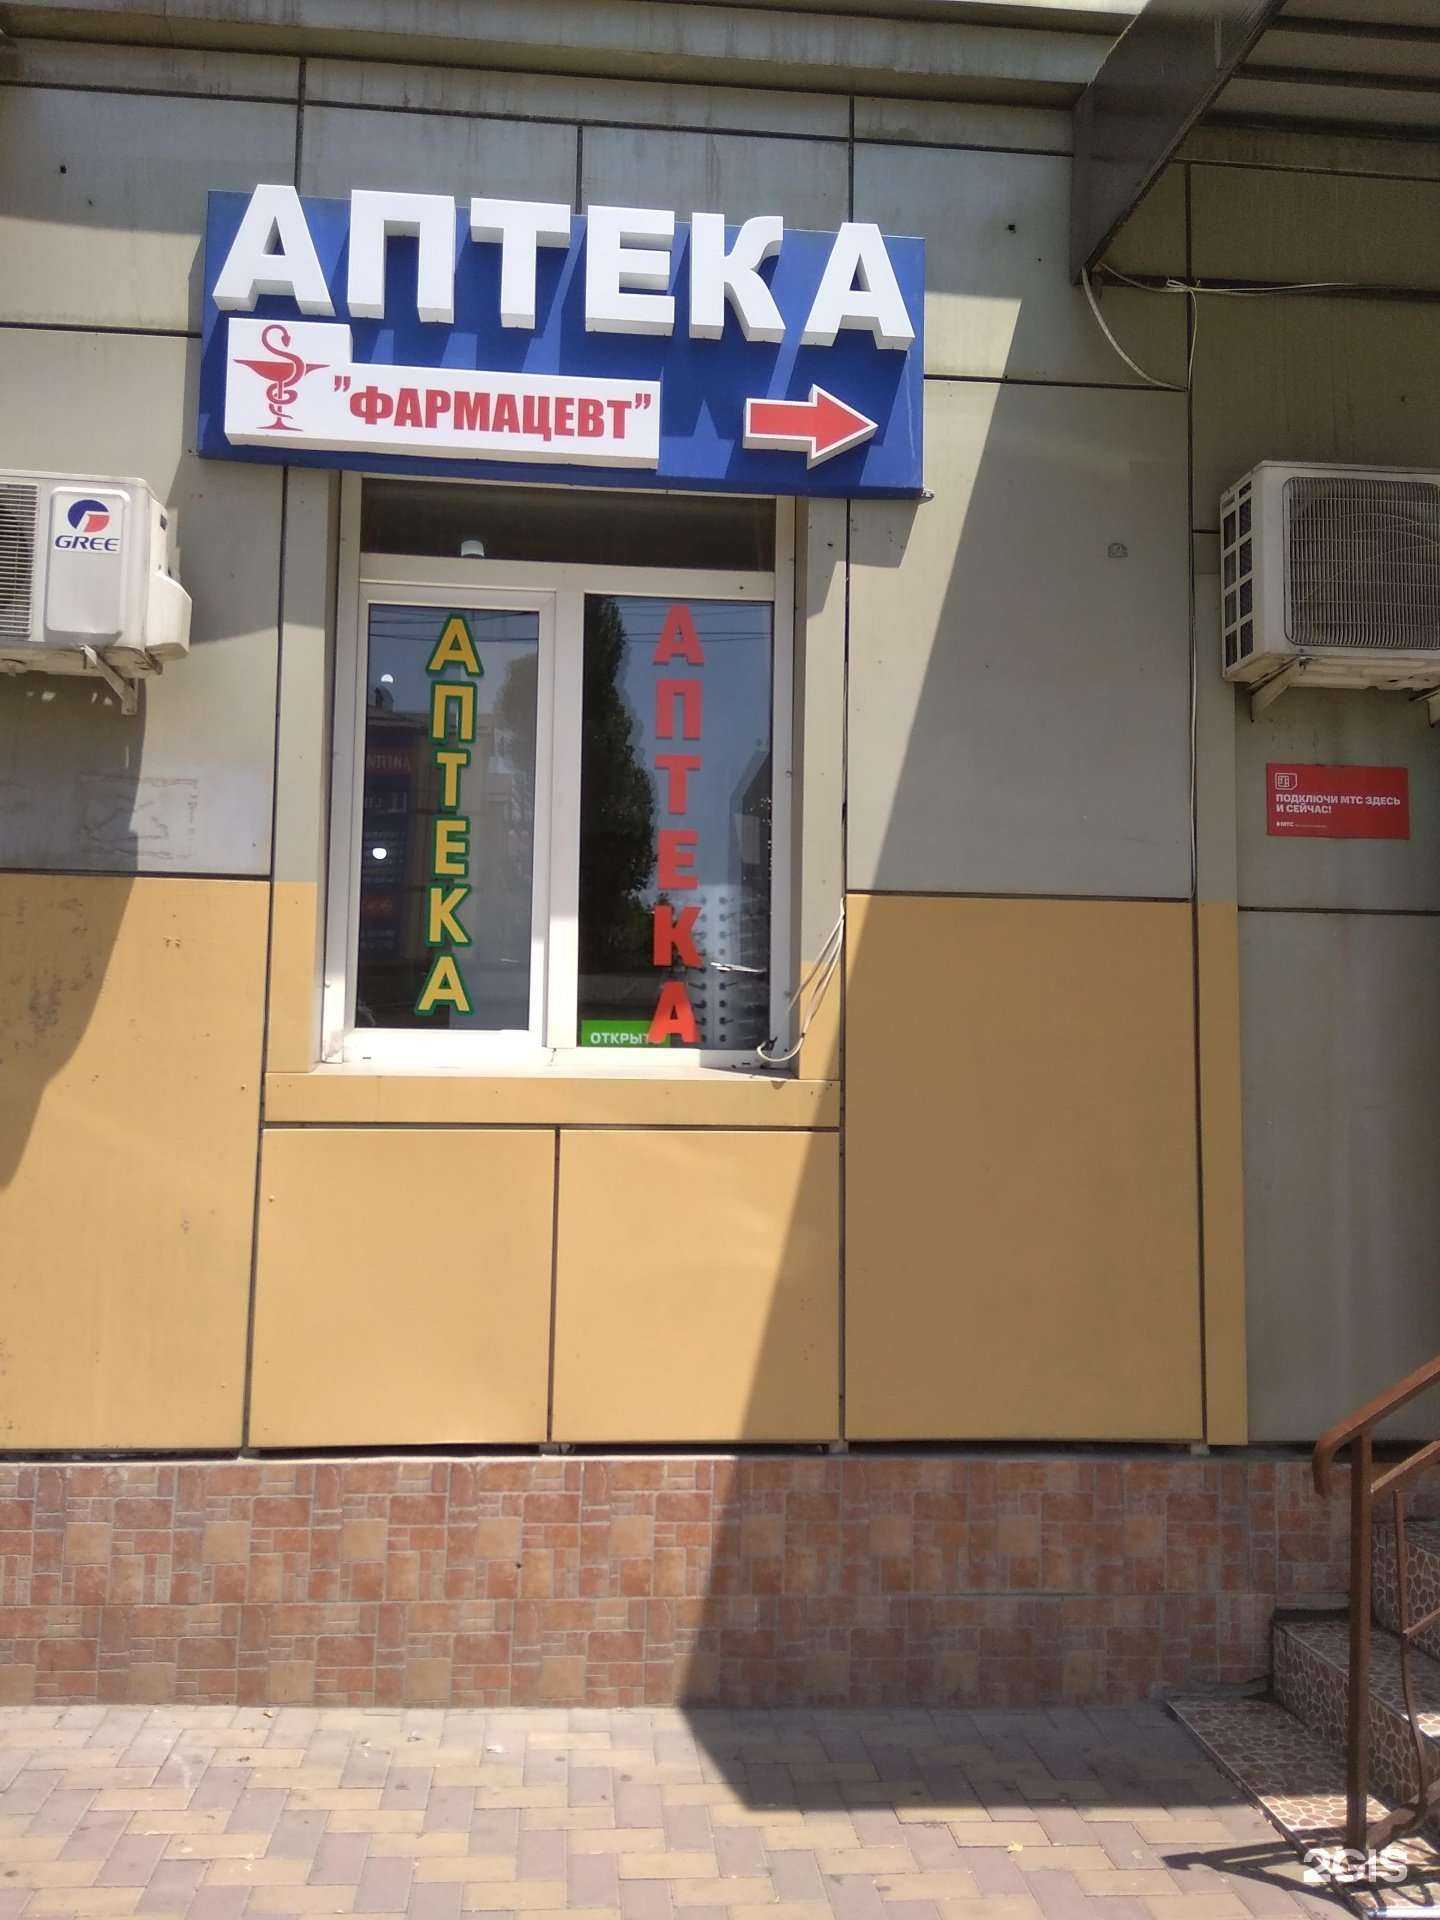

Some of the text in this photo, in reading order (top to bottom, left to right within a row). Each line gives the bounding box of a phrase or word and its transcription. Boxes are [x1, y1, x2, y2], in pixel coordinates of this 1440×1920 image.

[212, 184, 916, 351] АПТЕКА
[55, 534, 120, 552] GREE
[1275, 793, 1401, 806] ПОДКЛЮЧИ МТС ЗДЕСЬ
[1276, 802, 1332, 814] И СЕЙЧАС!
[414, 612, 484, 1016] АПТЕКА
[646, 603, 705, 1044] АПТЕКА
[590, 1031, 652, 1045] ОТКРЫТ
